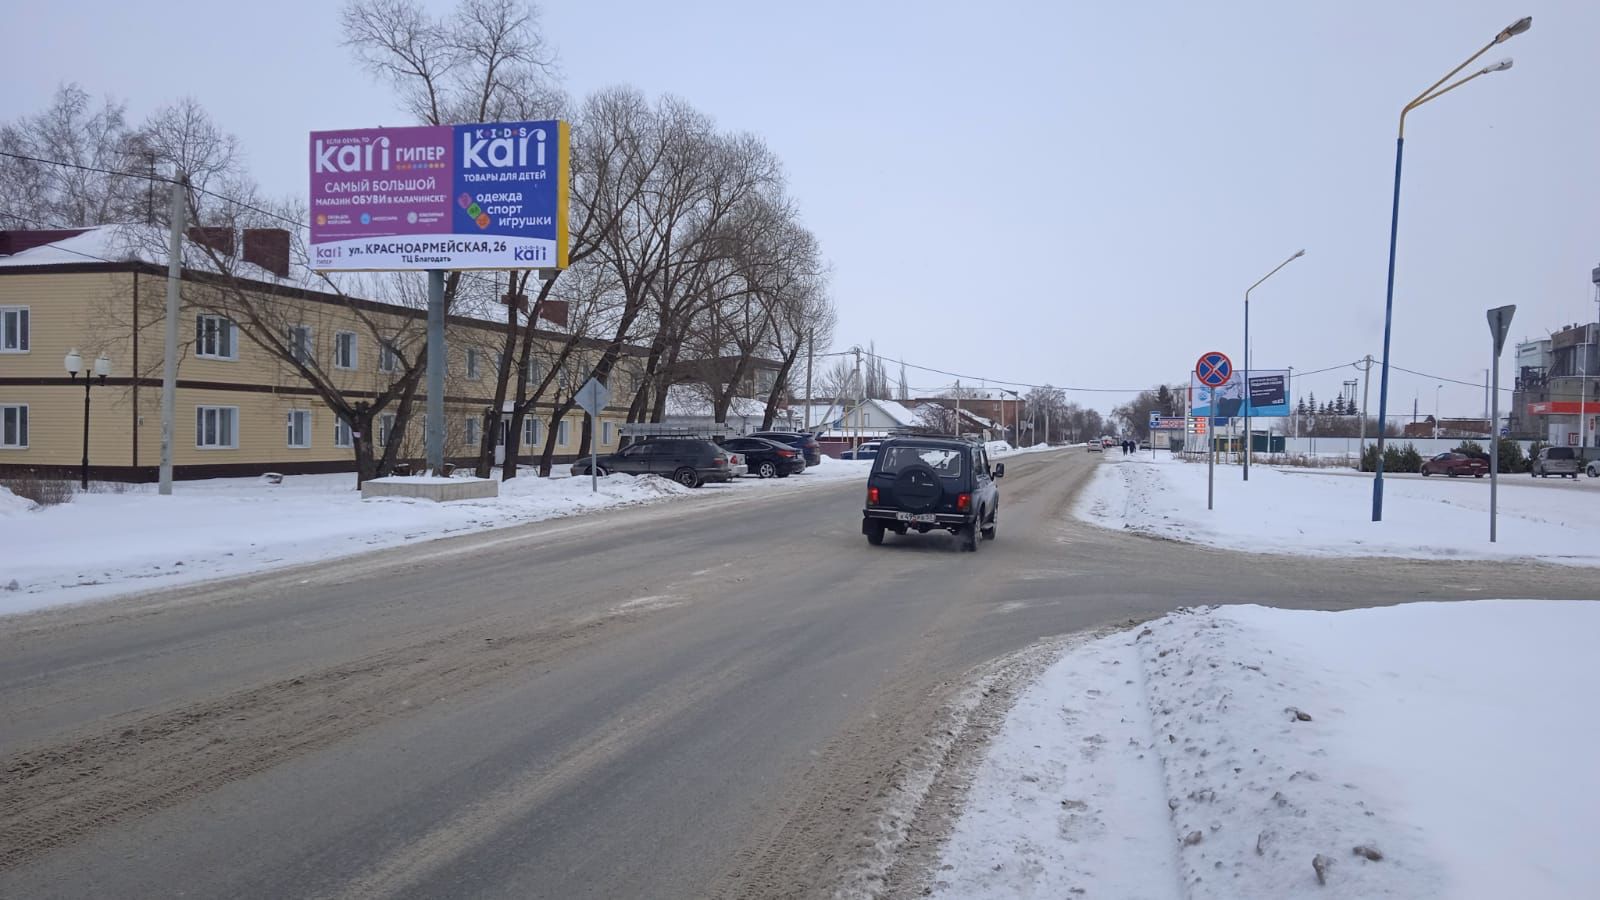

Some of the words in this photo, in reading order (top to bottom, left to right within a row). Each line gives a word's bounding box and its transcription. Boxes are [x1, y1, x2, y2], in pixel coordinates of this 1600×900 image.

[316, 136, 390, 172] kari
[396, 146, 445, 161] ГИПЕР
[464, 128, 547, 168] kari
[464, 173, 498, 182] ТОВАРЫ
[499, 172, 517, 182] ДЛЯ
[518, 170, 546, 181] ДЕТЕЙ
[325, 179, 370, 193] САМЫЙ
[373, 176, 436, 192] БОЛЬШОЙ
[352, 195, 387, 205] ОБУВИ
[476, 192, 522, 204] одежда
[488, 205, 522, 216] спорт
[499, 216, 552, 228] игрушки
[316, 246, 342, 258] kari
[349, 248, 364, 257] ул.
[366, 240, 492, 255] КРАСНОАРМЕЙСКАЯ,
[494, 241, 507, 252] 26
[514, 246, 546, 261] kari
[402, 256, 413, 264] ТЦ
[414, 255, 452, 263] Благодать
